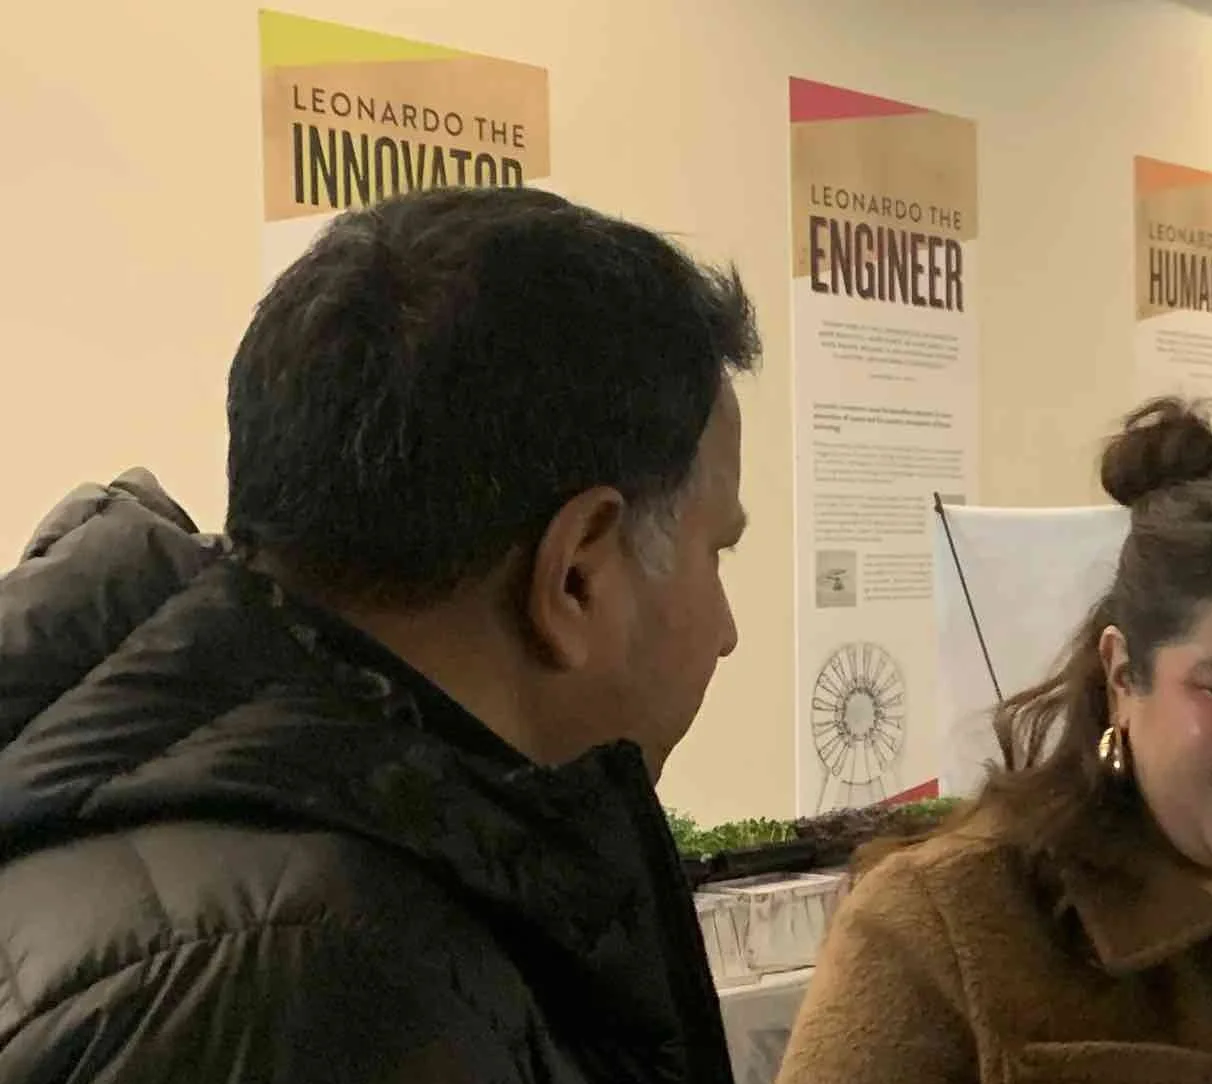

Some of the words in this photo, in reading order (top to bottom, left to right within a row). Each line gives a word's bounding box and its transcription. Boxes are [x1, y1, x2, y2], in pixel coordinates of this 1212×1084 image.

[293, 84, 463, 136] LEONARDO
[474, 117, 525, 148] THE
[810, 184, 922, 223] LEONARDO
[930, 206, 962, 231] THE
[810, 215, 965, 312] ENGINEER
